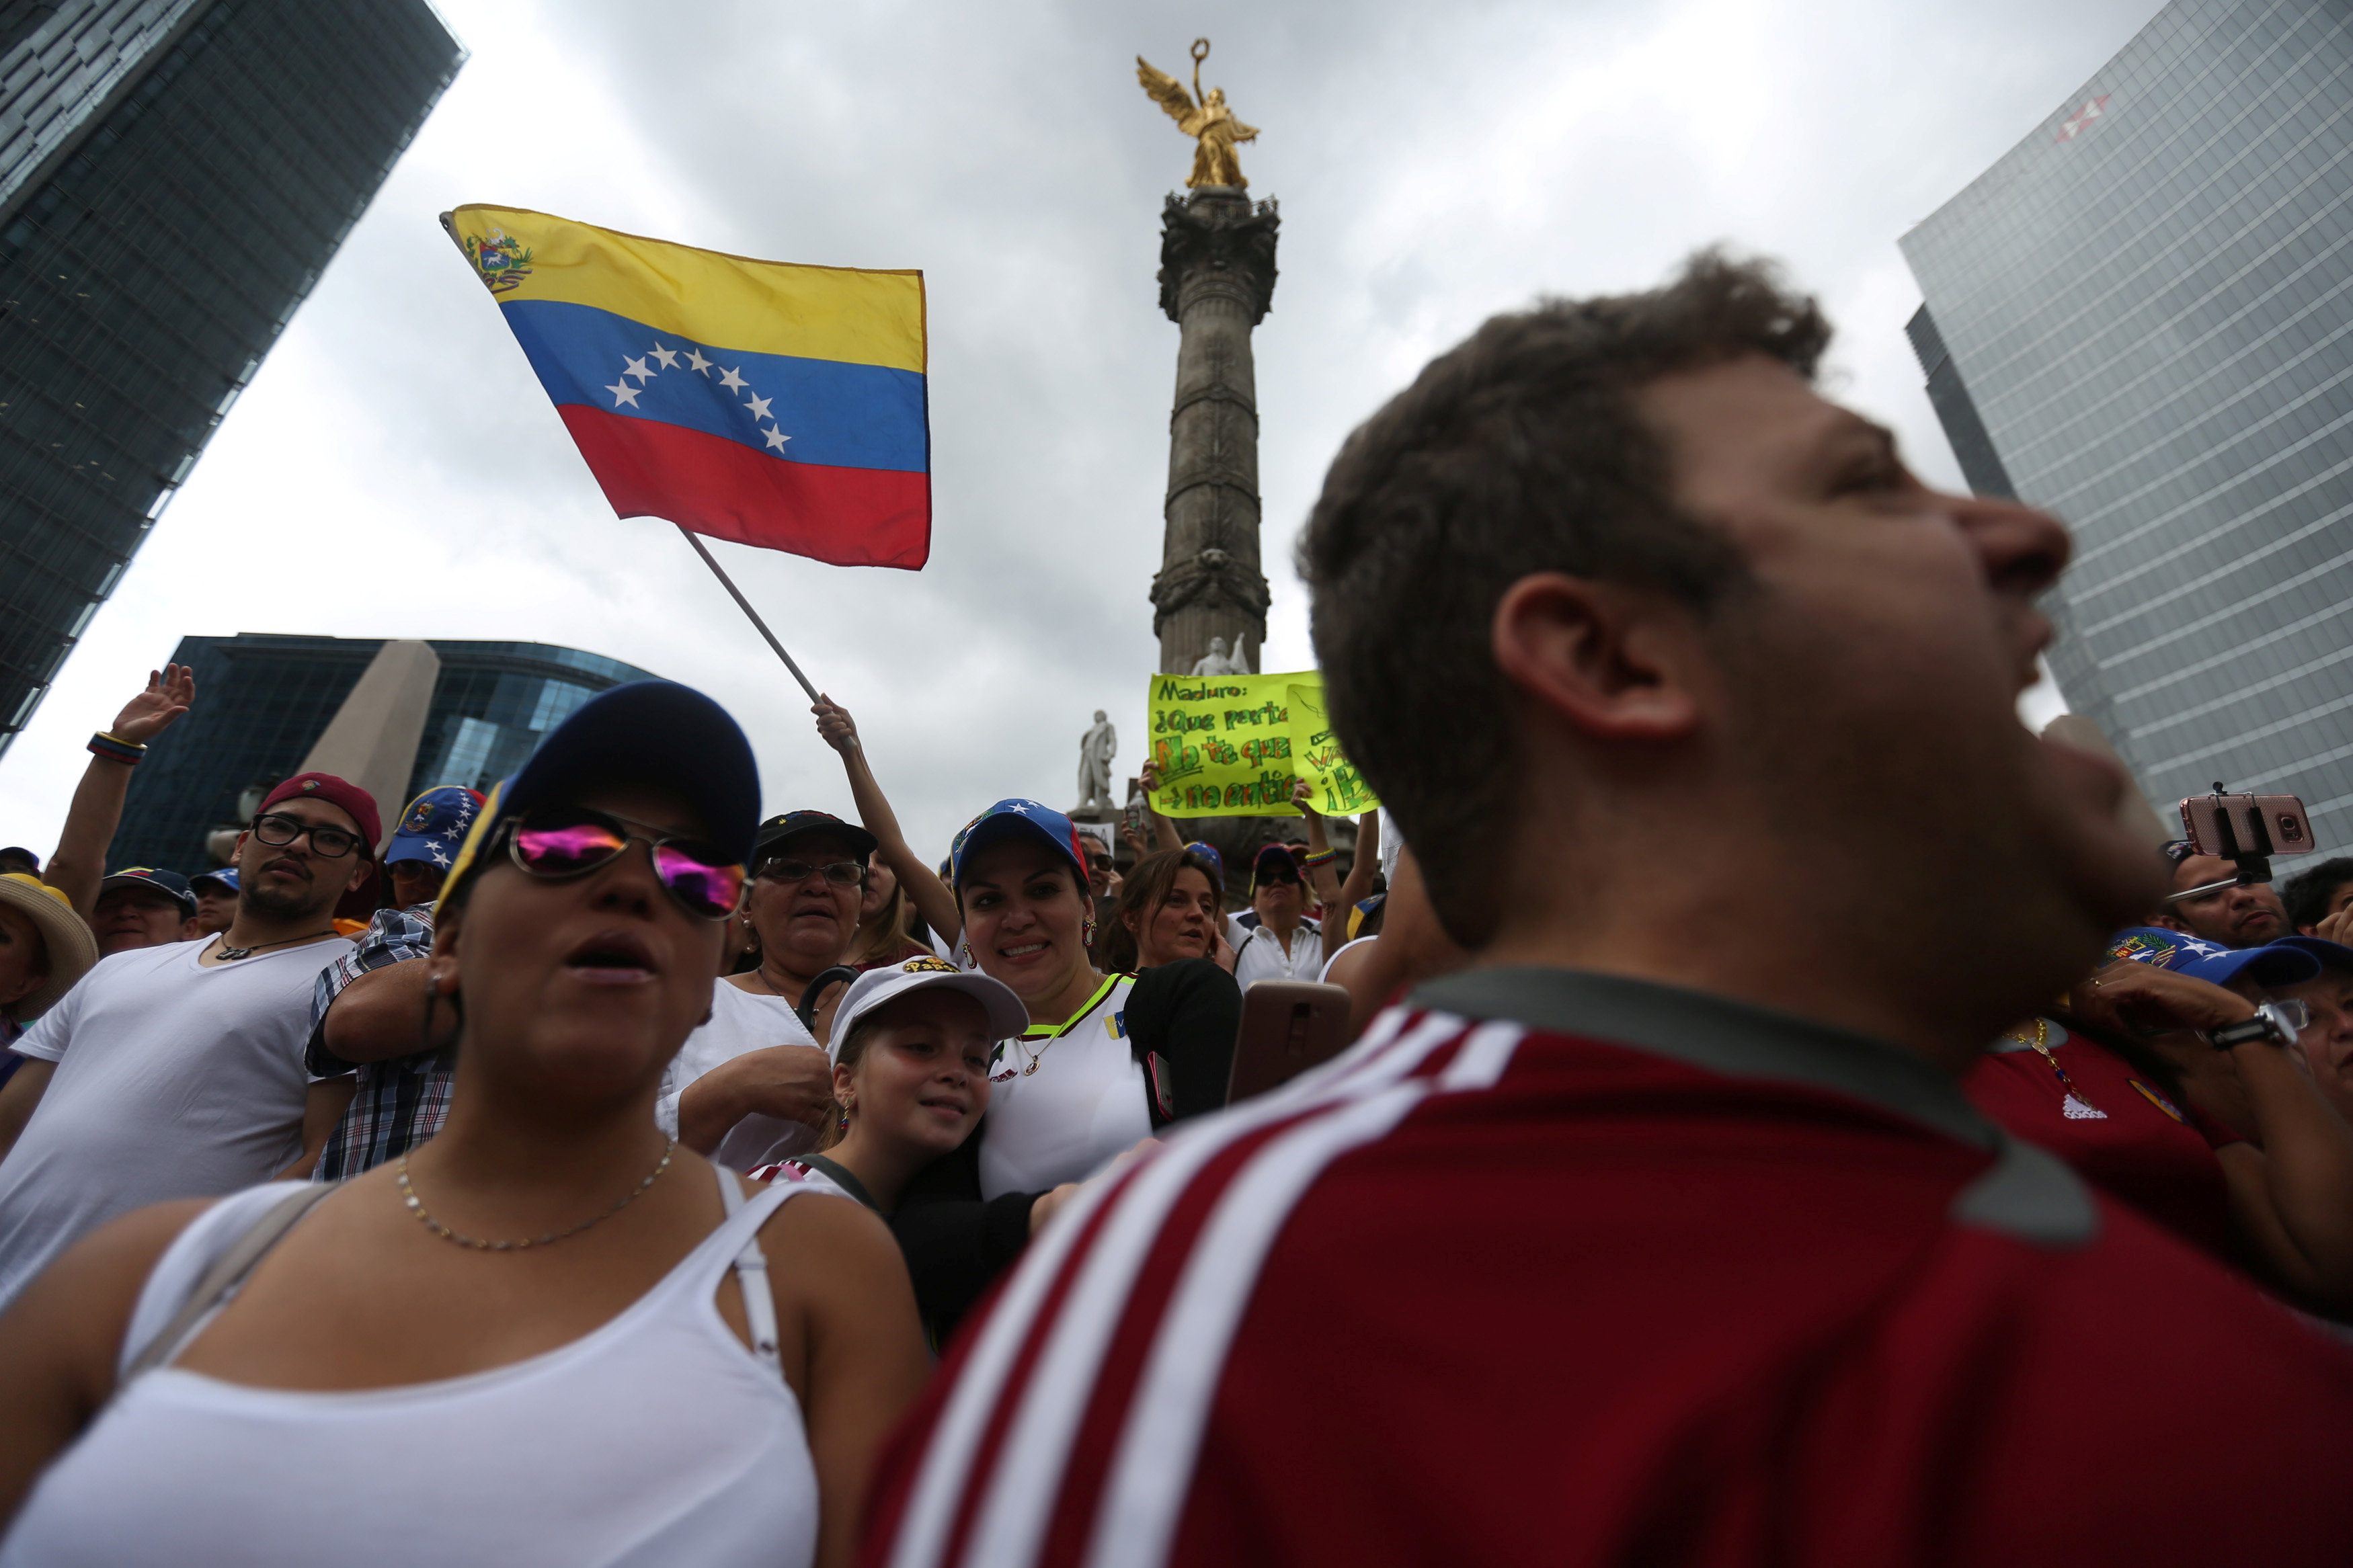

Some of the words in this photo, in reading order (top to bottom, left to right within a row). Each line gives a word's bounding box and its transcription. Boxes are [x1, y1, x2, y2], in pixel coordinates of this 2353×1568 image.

[1158, 679, 1248, 701] Maduro:
[1154, 708, 1215, 735] ¿Que
[1156, 735, 1200, 776] No
[1202, 735, 1238, 766] te
[1242, 735, 1293, 769] que
[1185, 783, 1222, 811] no
